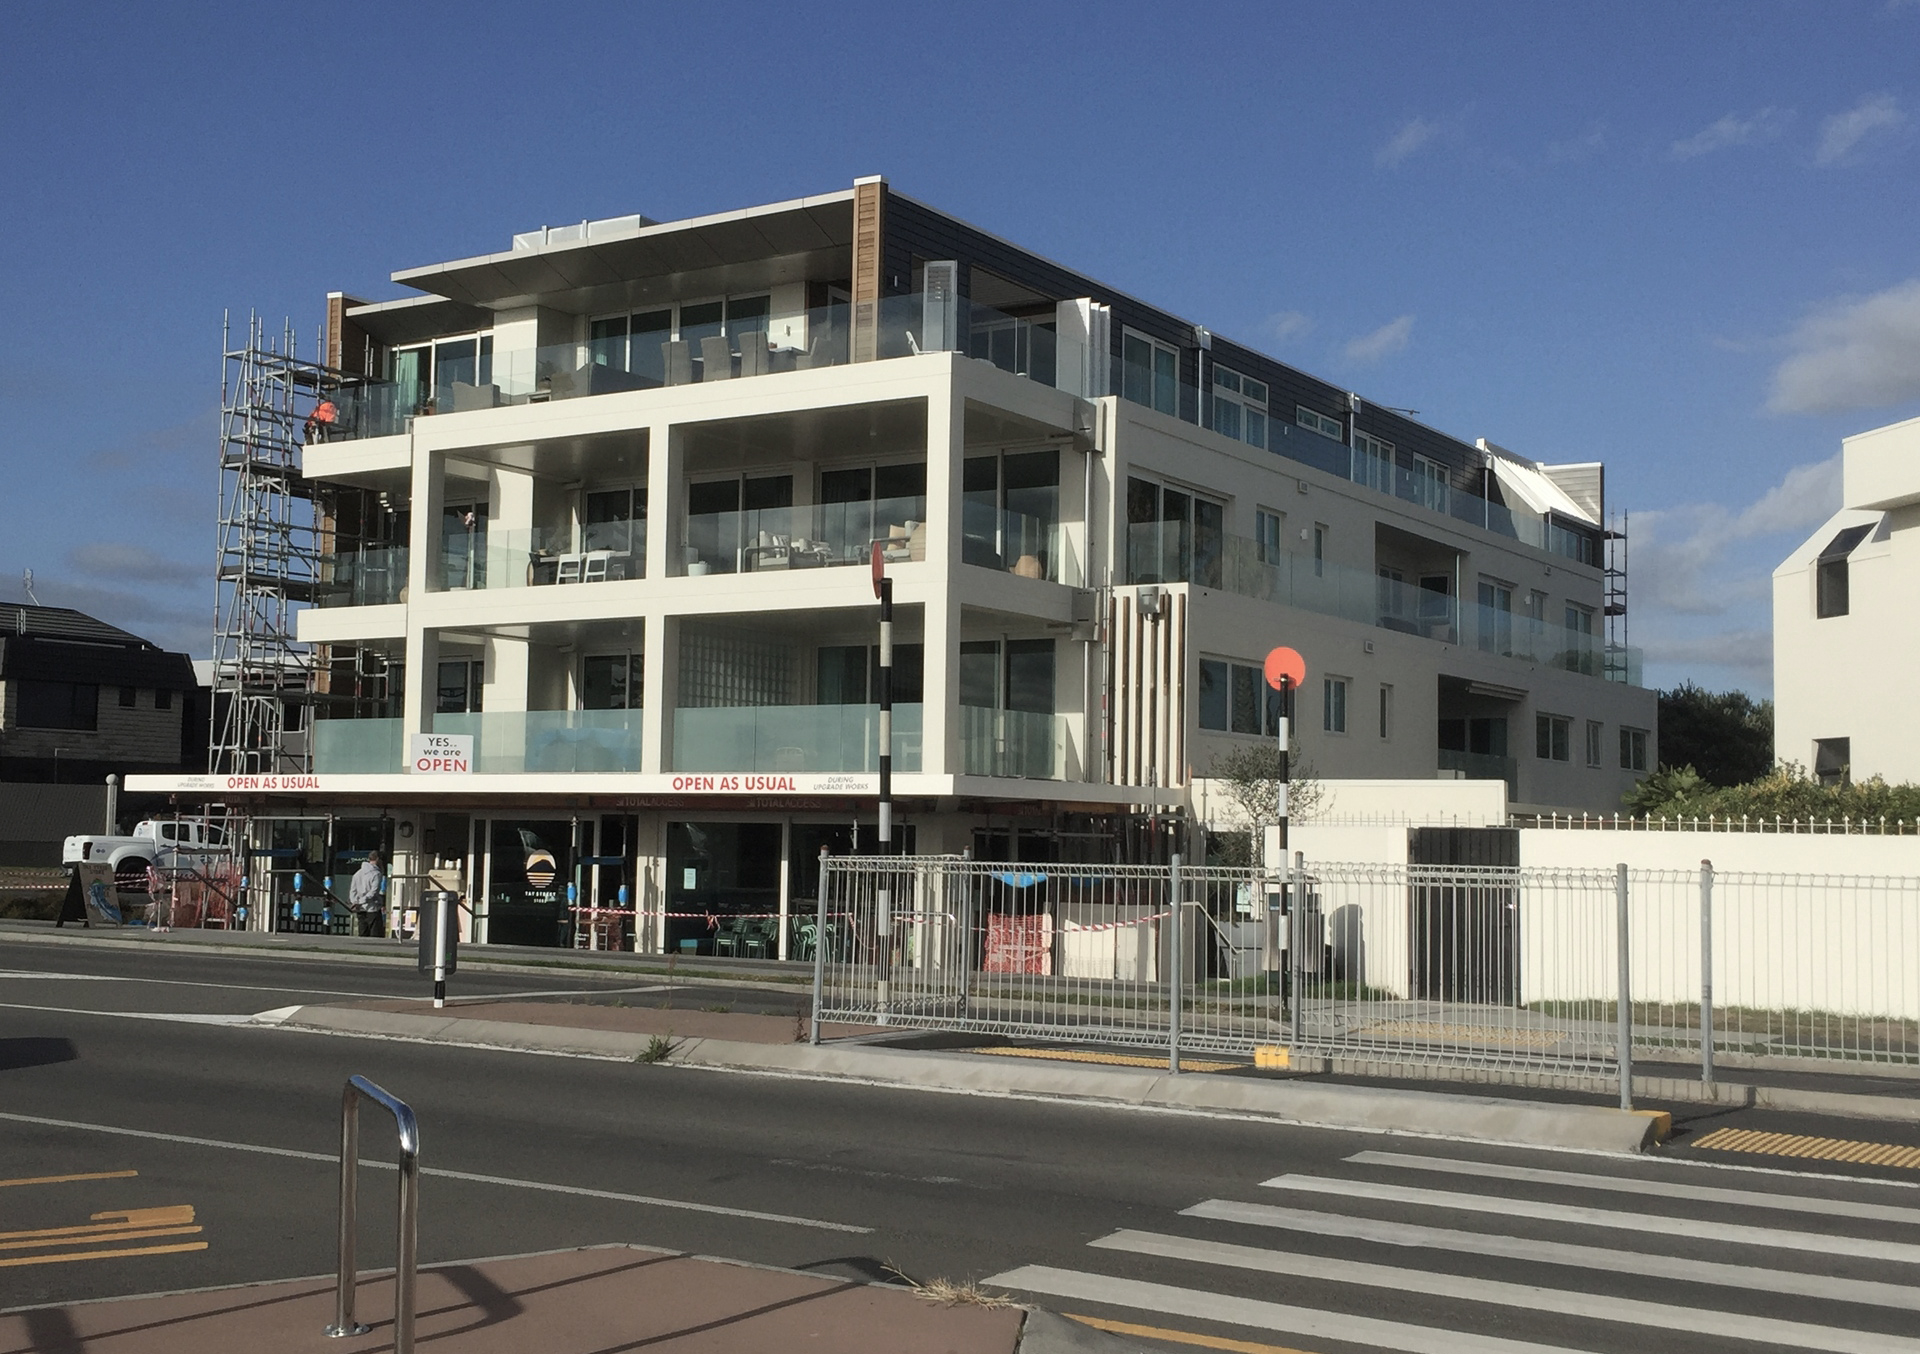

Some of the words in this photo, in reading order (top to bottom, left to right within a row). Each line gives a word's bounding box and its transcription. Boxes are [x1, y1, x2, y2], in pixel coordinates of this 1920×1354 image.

[417, 758, 467, 772] OPEN
[227, 776, 259, 789] OPEN
[262, 776, 278, 789] AS
[281, 776, 320, 789] USUAL
[672, 777, 714, 790] OPEN
[719, 777, 739, 790] AS
[745, 777, 796, 791] USUAL
